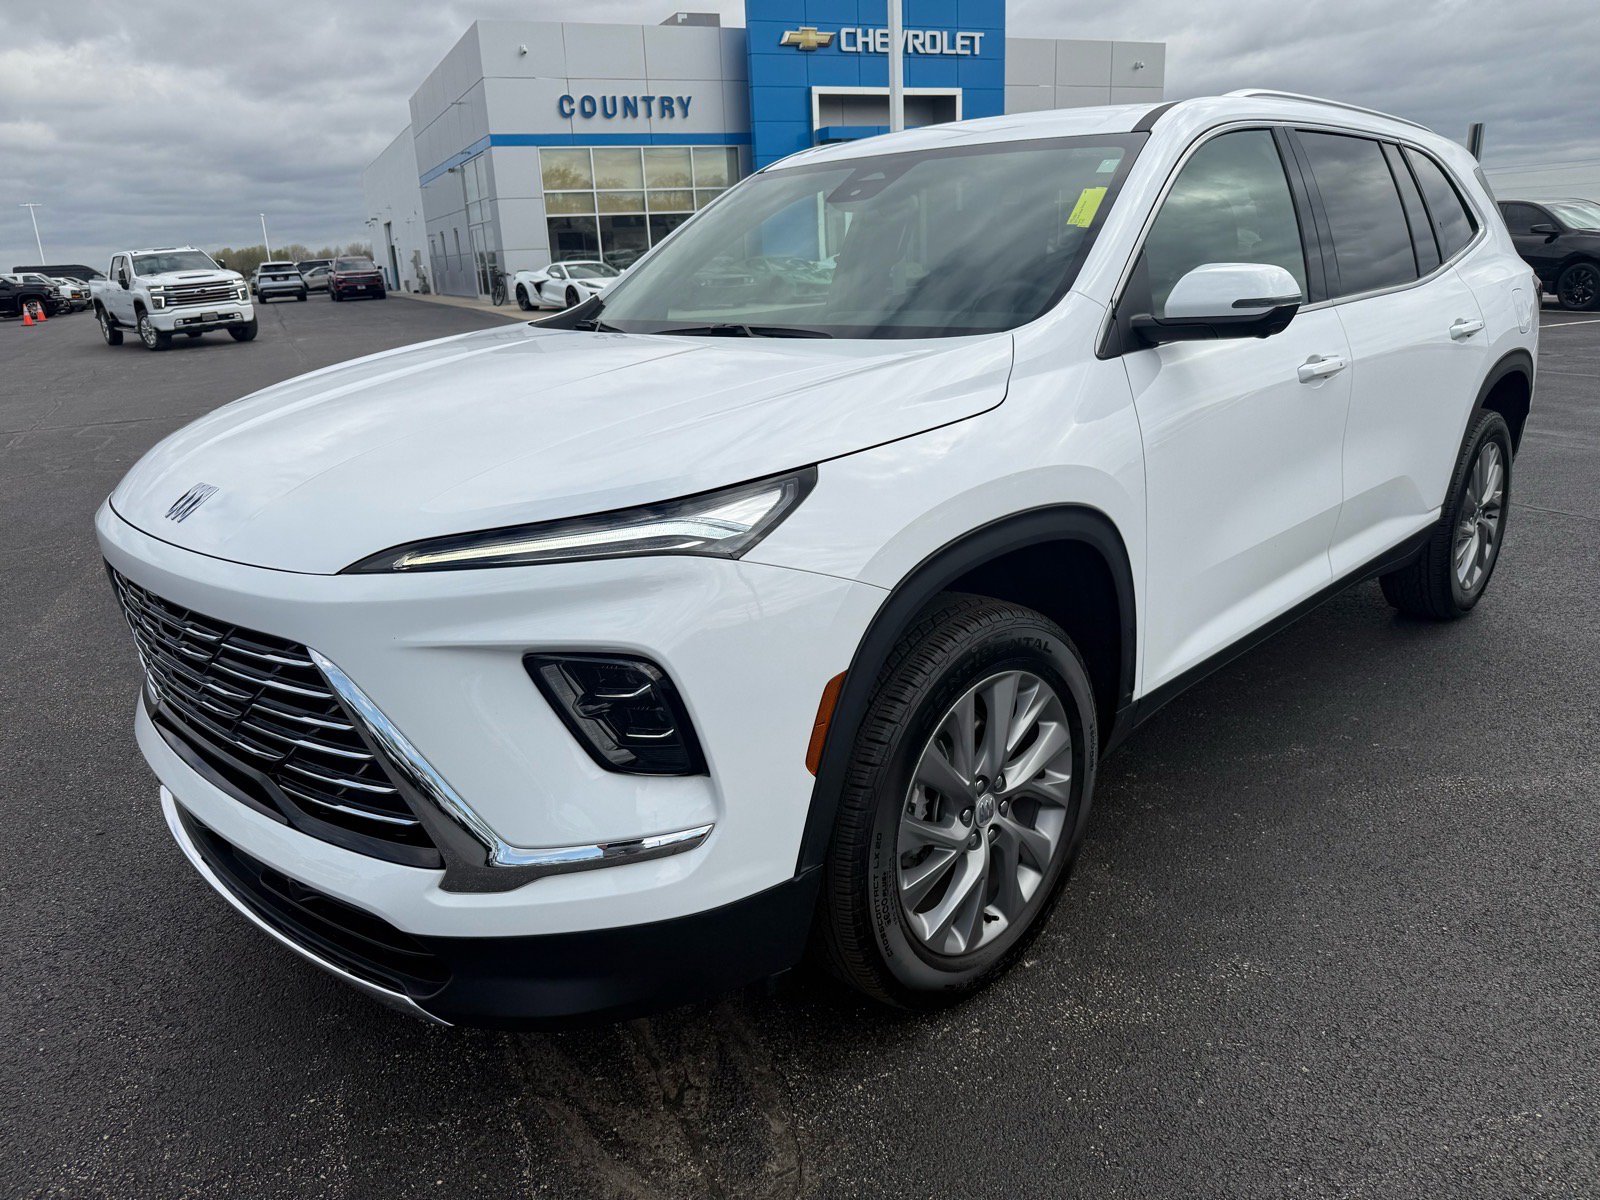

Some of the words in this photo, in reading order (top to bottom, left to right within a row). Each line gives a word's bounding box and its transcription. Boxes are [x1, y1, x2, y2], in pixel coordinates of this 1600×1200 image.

[558, 94, 692, 119] COUNTRY
[873, 852, 880, 869] LX
[873, 874, 893, 957] CROSSCONTACT
